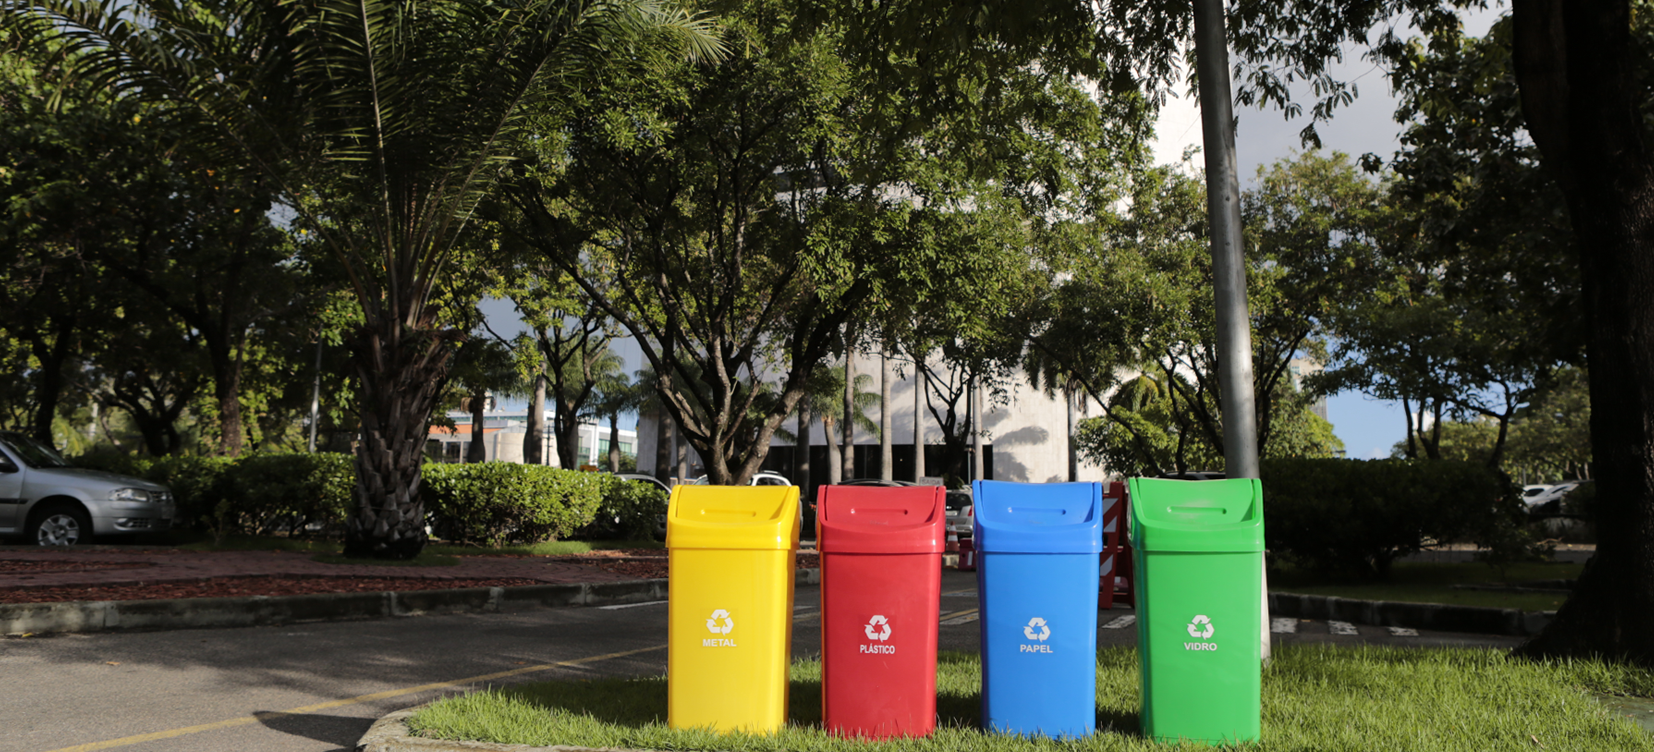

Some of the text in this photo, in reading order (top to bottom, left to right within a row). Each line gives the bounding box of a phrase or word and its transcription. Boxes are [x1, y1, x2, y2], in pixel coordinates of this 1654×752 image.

[702, 638, 737, 647] METAL
[1183, 642, 1218, 651] VIDRO
[860, 643, 896, 655] PLÁSTICO
[1020, 644, 1053, 653] PAPEL
